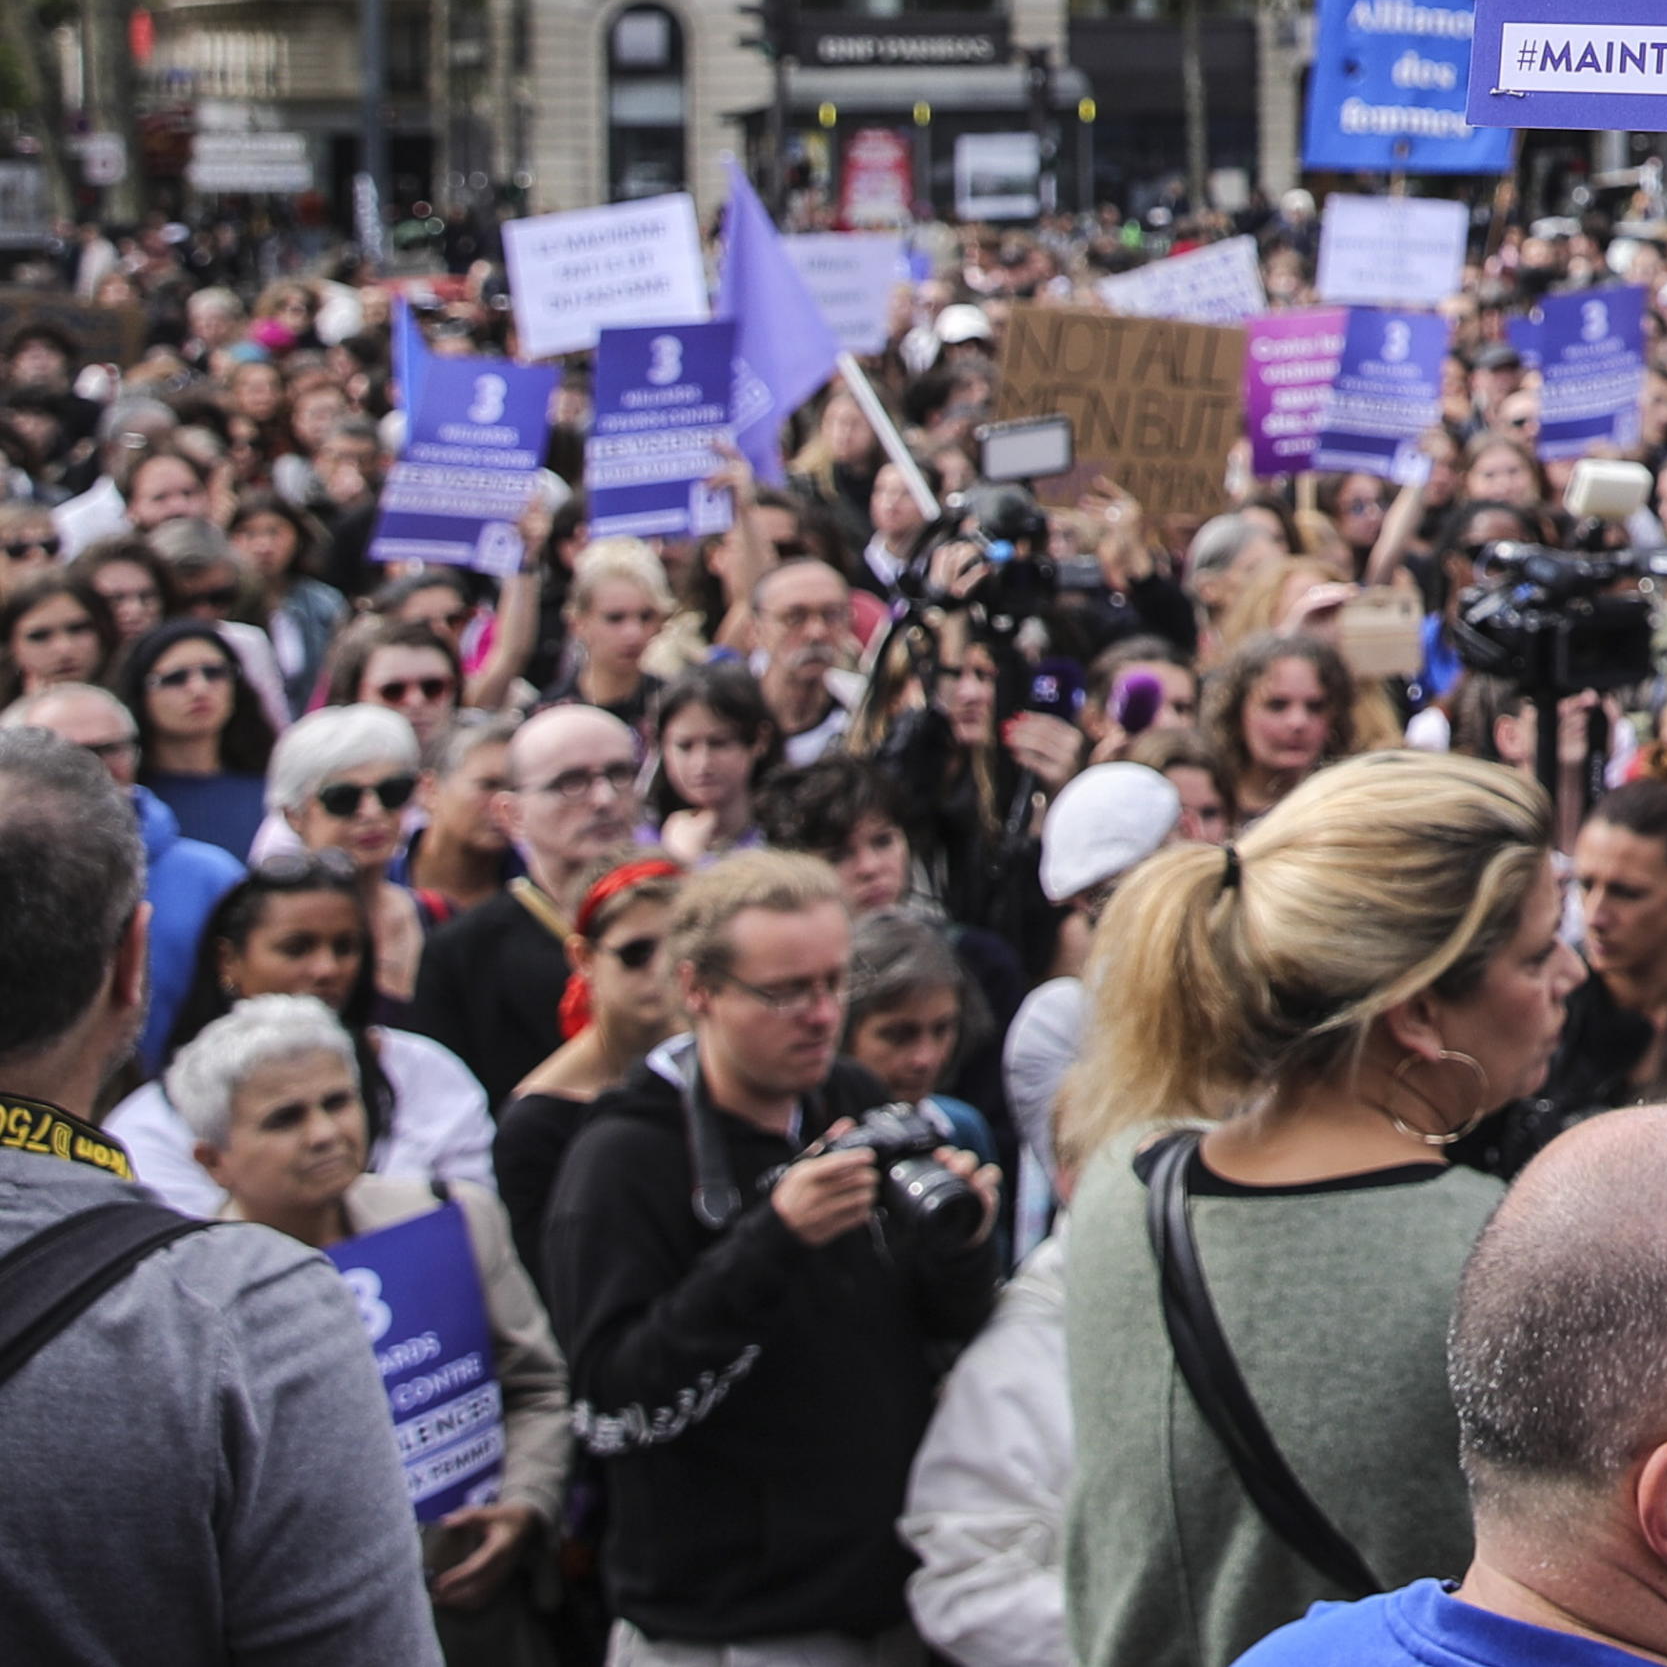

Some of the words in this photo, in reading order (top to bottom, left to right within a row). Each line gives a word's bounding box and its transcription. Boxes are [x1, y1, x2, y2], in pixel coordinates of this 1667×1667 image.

[1006, 313, 1131, 381] NOT
[1132, 321, 1233, 391] ALL
[1131, 389, 1228, 458] BUT
[399, 1395, 493, 1452] LENCES
